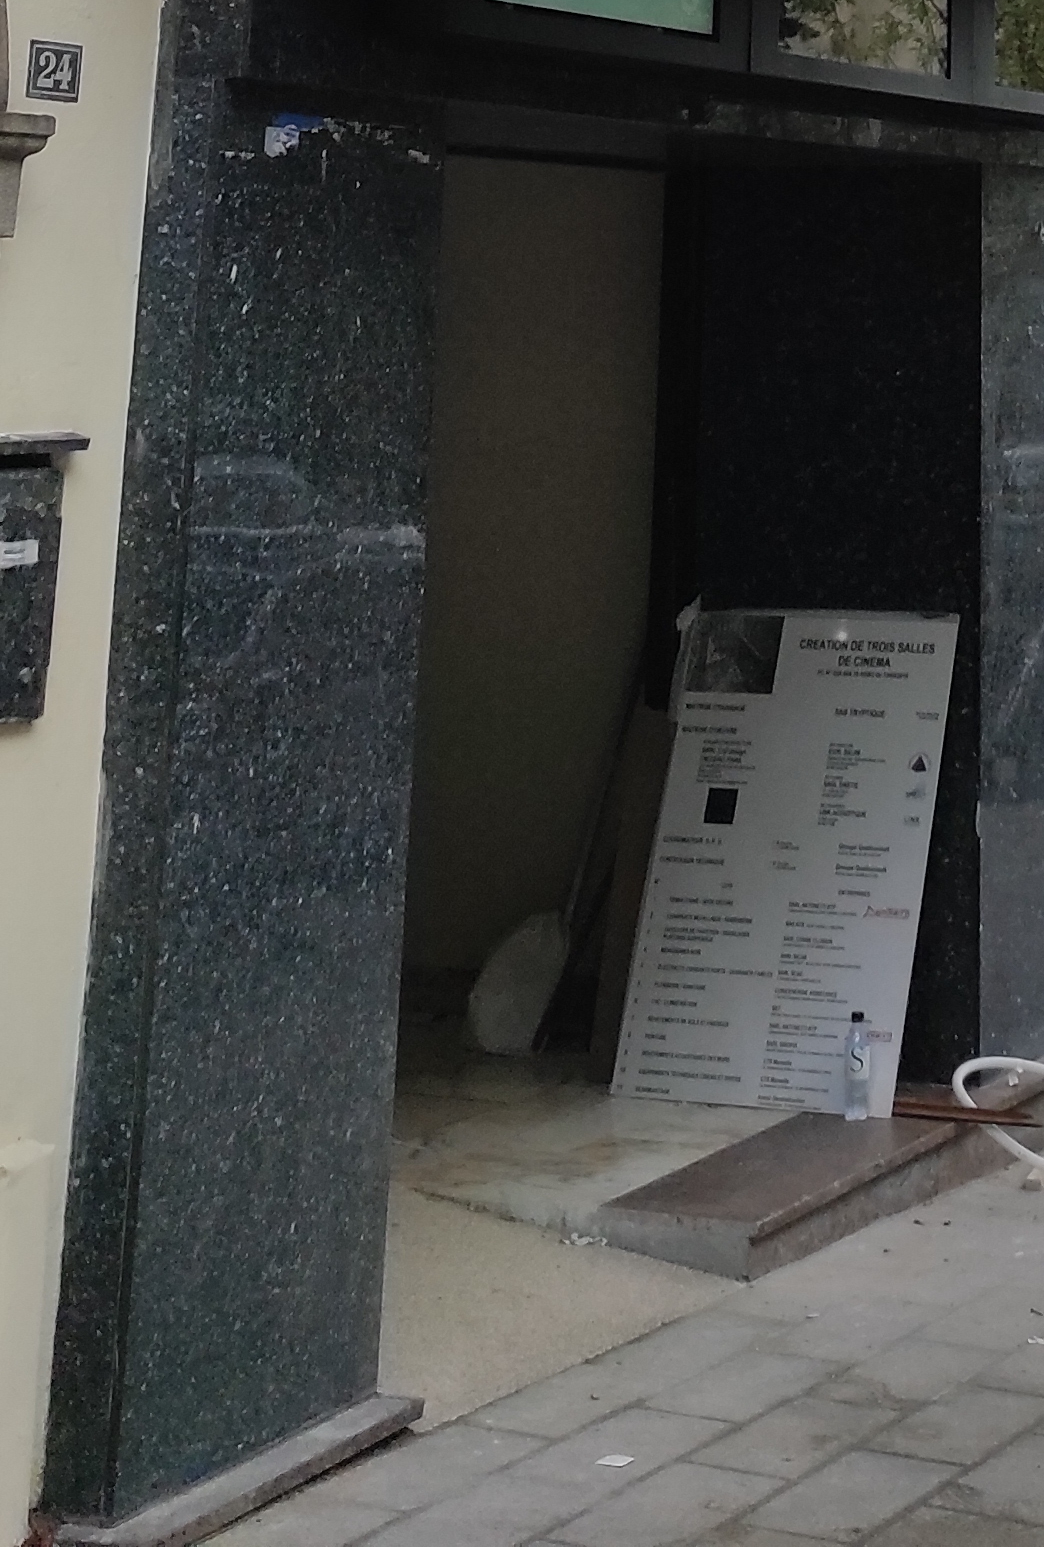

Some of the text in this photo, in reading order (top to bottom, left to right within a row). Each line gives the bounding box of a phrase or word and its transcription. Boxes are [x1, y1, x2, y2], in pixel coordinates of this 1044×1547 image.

[36, 48, 72, 92] 24
[799, 638, 936, 655] CREATION DE TROIS SALLES
[853, 655, 891, 668] CINEMA
